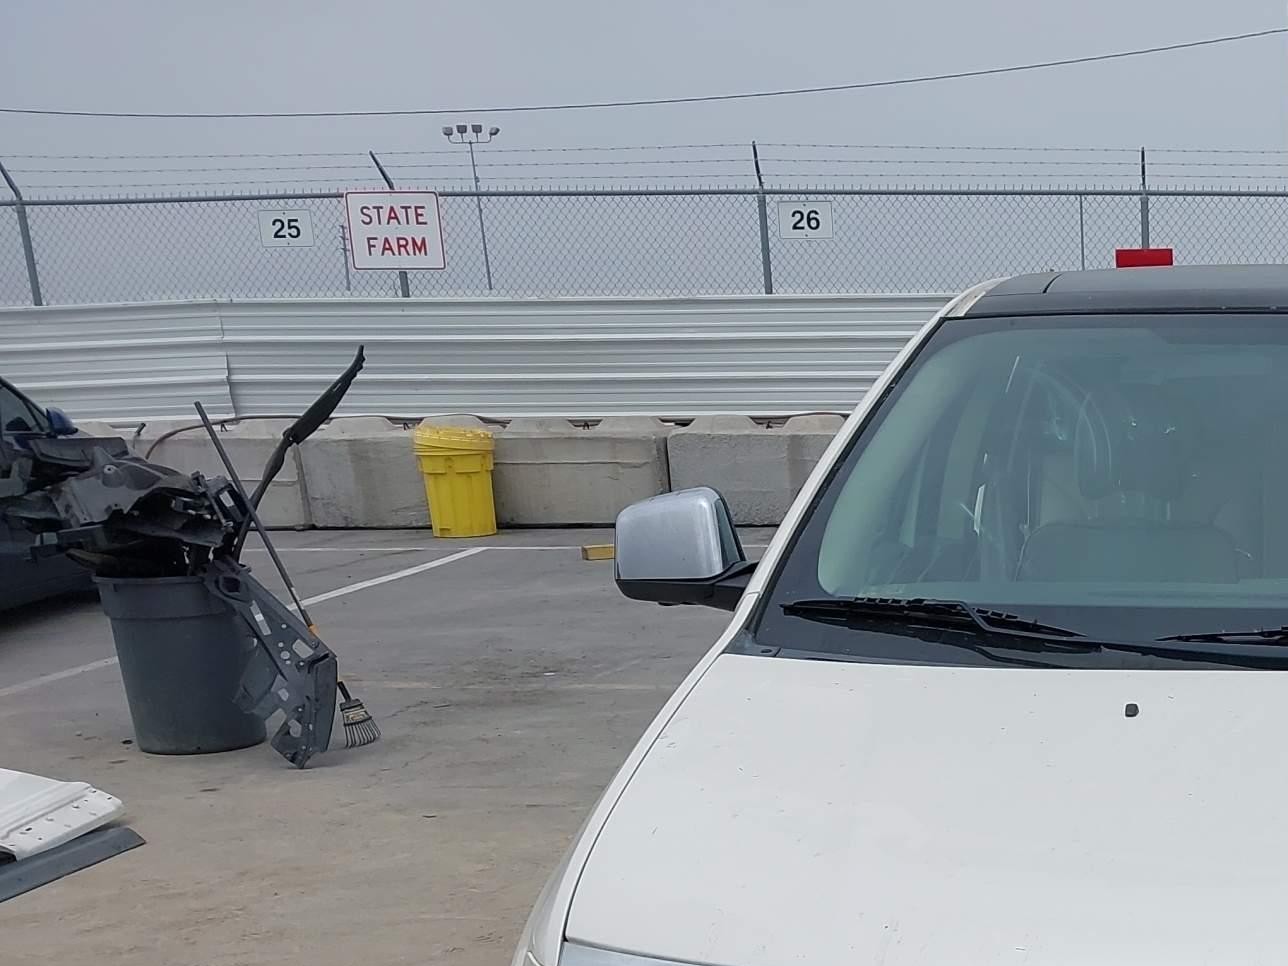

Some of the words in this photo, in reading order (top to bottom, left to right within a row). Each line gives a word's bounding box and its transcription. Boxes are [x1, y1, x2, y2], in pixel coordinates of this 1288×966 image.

[360, 206, 427, 225] STATE
[791, 209, 820, 230] 26
[272, 219, 300, 239] 25
[366, 237, 428, 256] FARM
